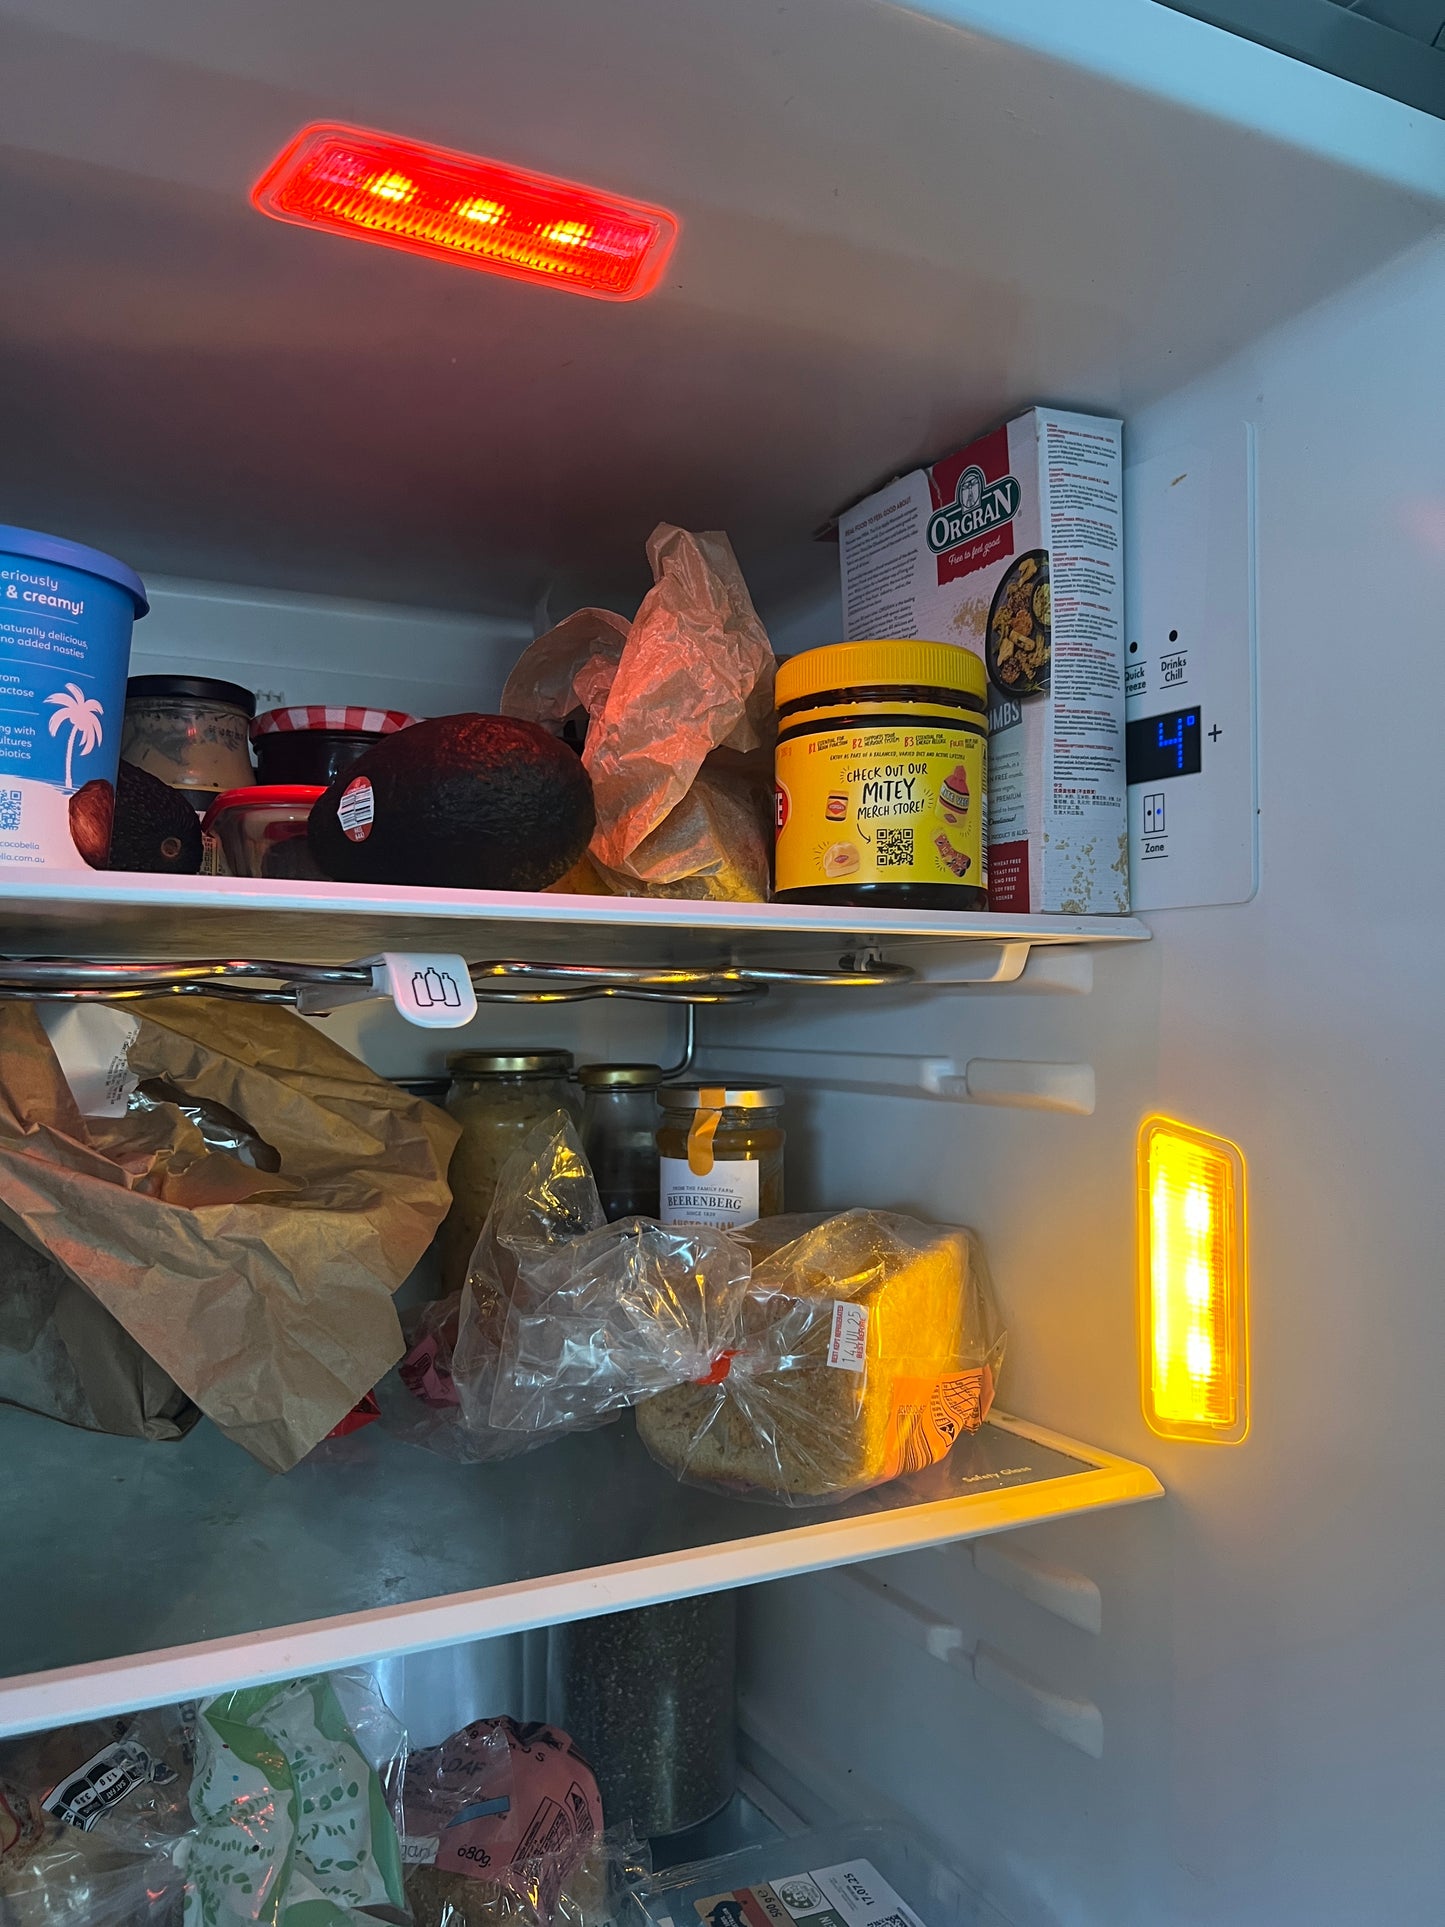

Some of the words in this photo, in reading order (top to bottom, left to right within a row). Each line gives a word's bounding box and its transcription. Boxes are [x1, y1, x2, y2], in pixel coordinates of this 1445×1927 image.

[931, 483, 1012, 548] ORGRAN
[948, 553, 964, 566] Free
[971, 545, 984, 560] feel
[983, 535, 1001, 557] good
[1, 569, 58, 591] eriously
[6, 584, 18, 599] &
[23, 590, 84, 615] creamy!
[0, 636, 15, 645] no
[17, 638, 51, 651] added
[53, 645, 85, 659] nasties
[48, 630, 89, 650] delicious,
[1161, 656, 1187, 672] Drinks
[0, 674, 20, 683] rom
[1125, 667, 1145, 682] Quick
[1165, 668, 1183, 682] Chill
[0, 686, 35, 698] actose
[1125, 681, 1147, 693] reeze
[14, 725, 36, 736] with
[0, 736, 32, 748] ultures
[852, 738, 862, 749] B2
[904, 737, 914, 748] B3
[0, 747, 31, 760] biotics
[847, 766, 881, 783] CHECK
[885, 764, 904, 777] OUT
[908, 763, 928, 775] OUR
[863, 777, 916, 804] MITEY
[858, 804, 890, 820] MERCH
[893, 799, 925, 815] STORE!
[1144, 842, 1165, 854] Zone
[667, 1195, 742, 1209] BEERENBERG
[847, 1311, 861, 1326] 25
[858, 1318, 866, 1342] BEFORE
[845, 1330, 859, 1350] JUL
[856, 1343, 864, 1359] BEST
[105, 1787, 117, 1799] FAT
[116, 1780, 126, 1791] SAT
[401, 1843, 430, 1860] gan
[457, 1844, 491, 1868] 680g.
[843, 1872, 876, 1906] 17.07.25
[766, 1904, 783, 1918] 500
